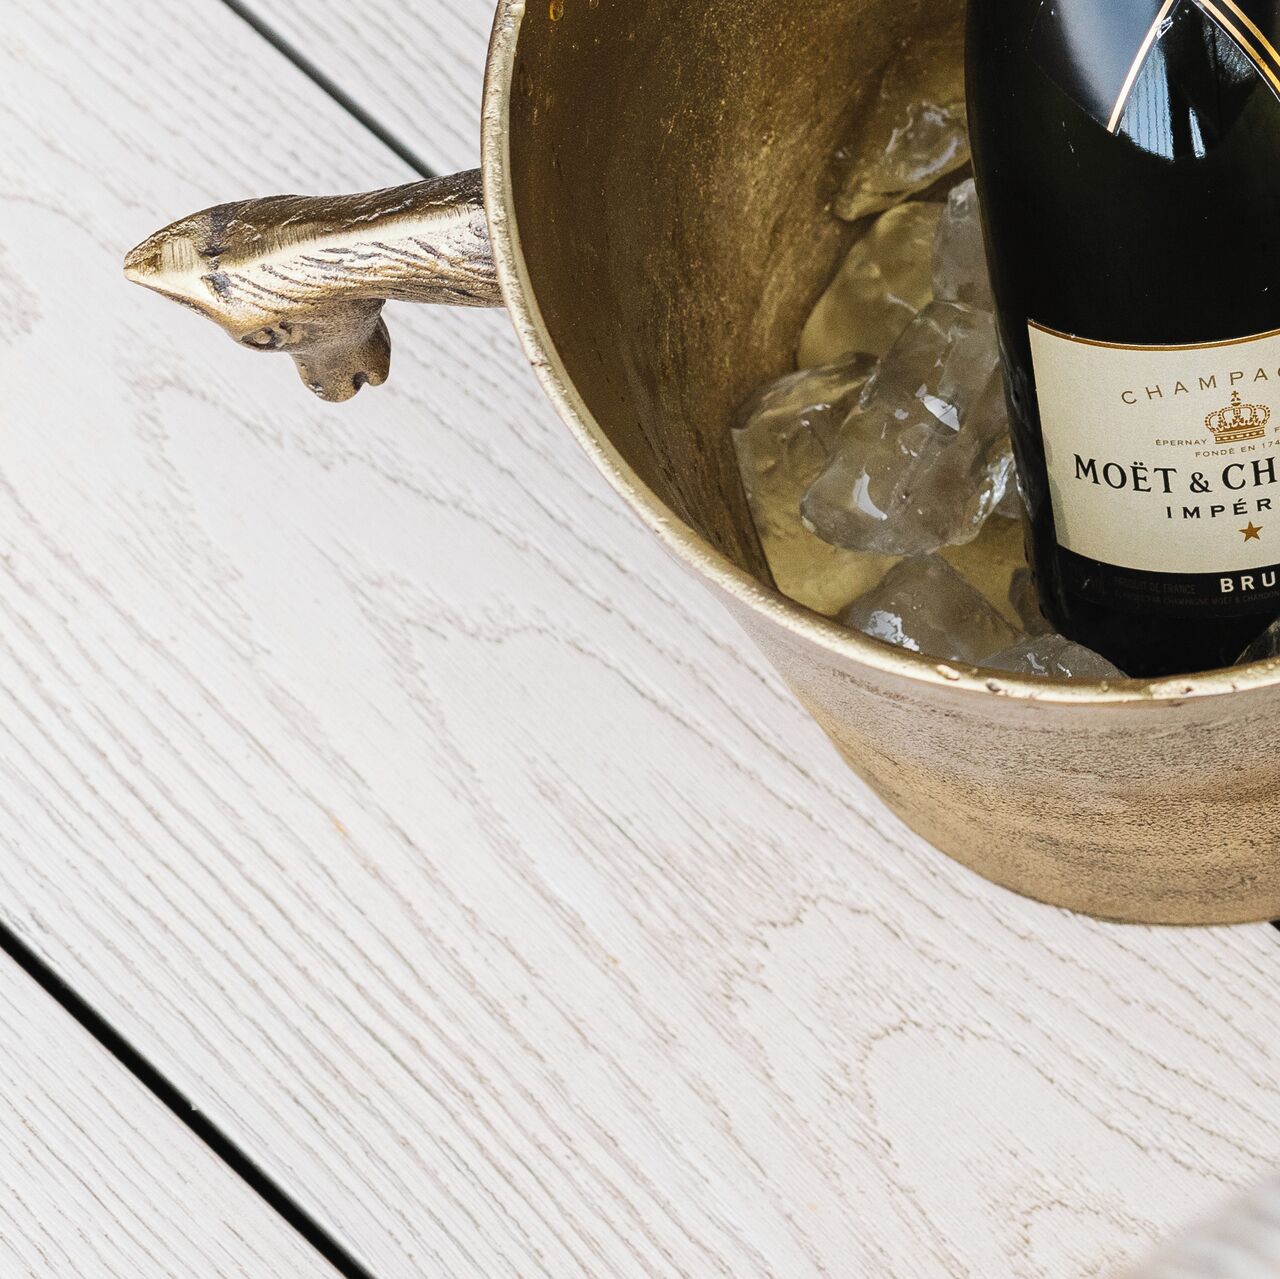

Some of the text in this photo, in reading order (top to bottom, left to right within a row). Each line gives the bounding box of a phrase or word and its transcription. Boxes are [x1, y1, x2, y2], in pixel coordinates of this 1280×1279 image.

[1155, 438, 1207, 446] ÉPERNAY
[1195, 447, 1235, 458] FONDÉ
[1240, 444, 1256, 453] EN
[1073, 453, 1177, 494] MOËT
[1189, 471, 1213, 494] &
